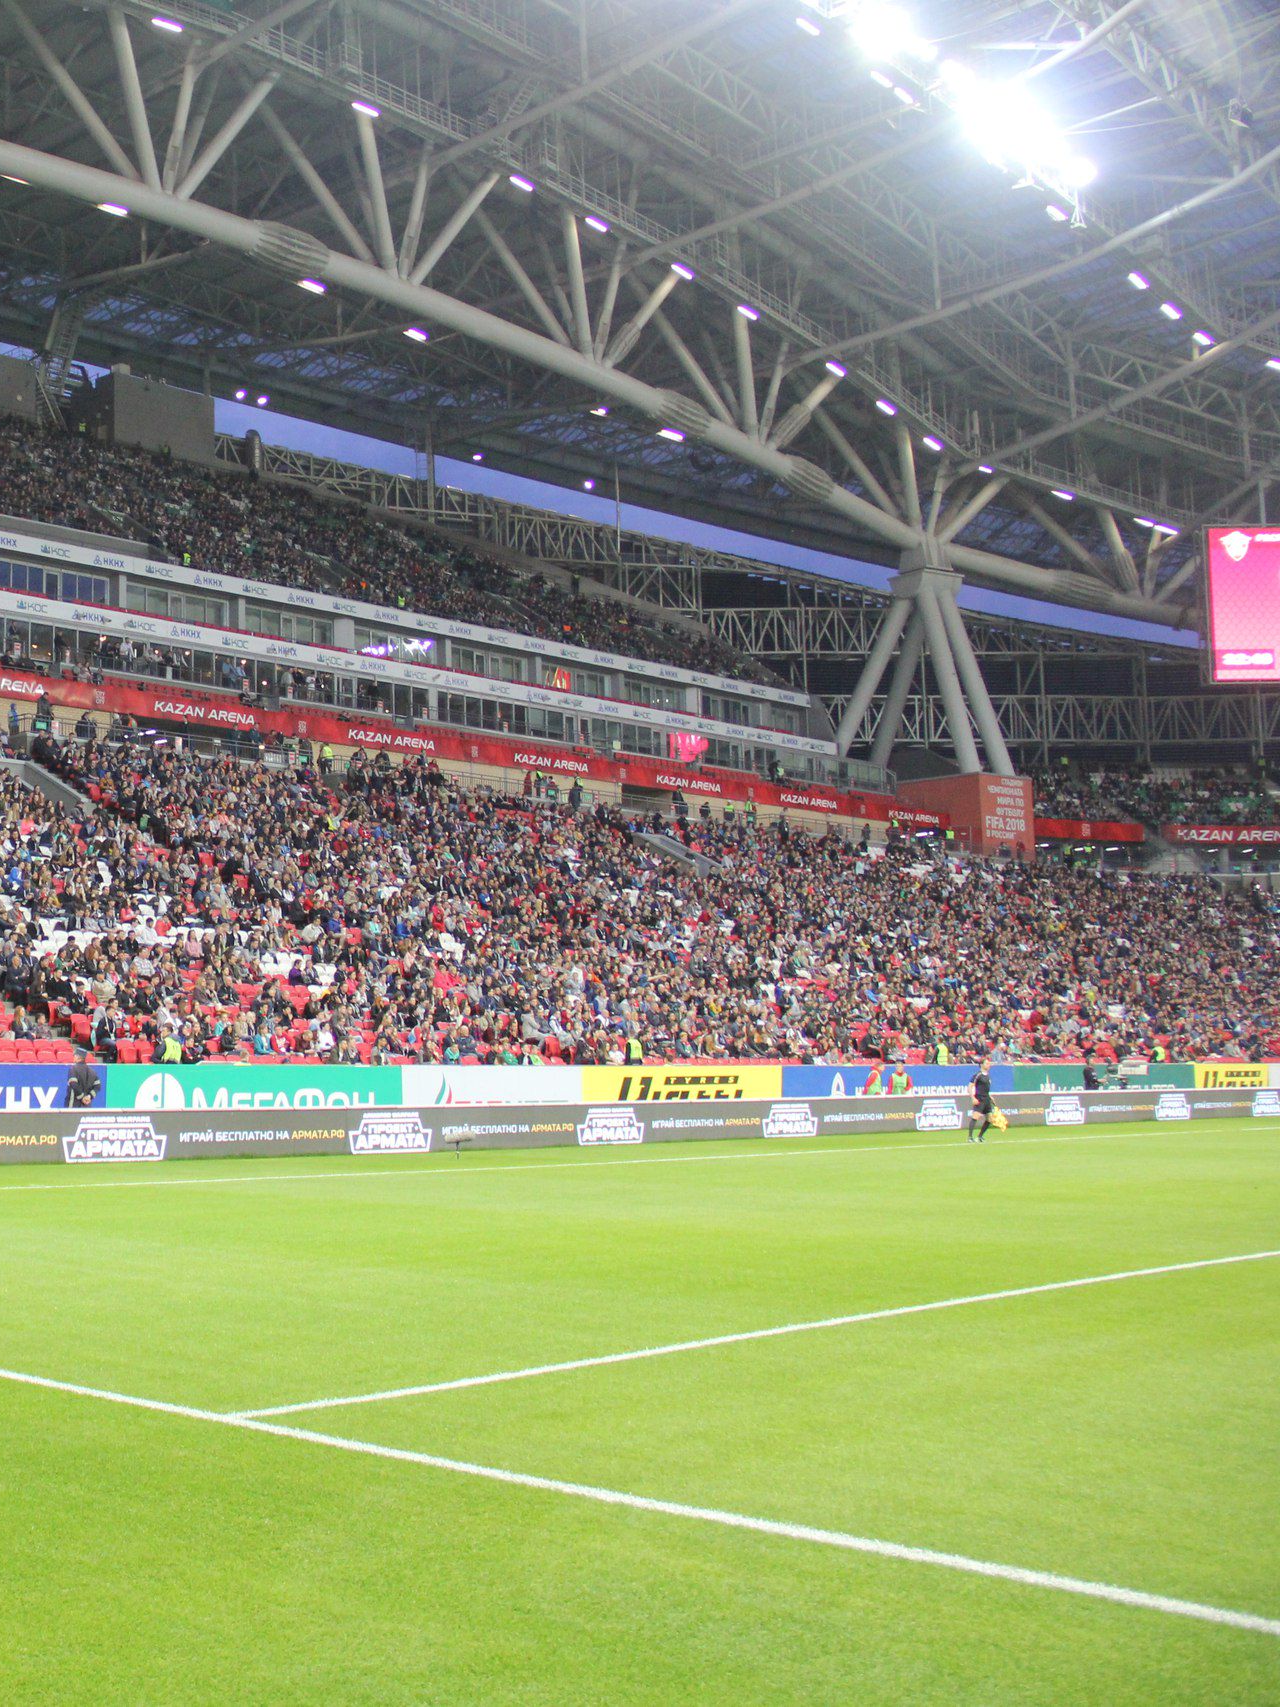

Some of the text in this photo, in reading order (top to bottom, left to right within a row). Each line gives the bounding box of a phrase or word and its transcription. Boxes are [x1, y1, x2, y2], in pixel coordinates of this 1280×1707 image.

[103, 557, 125, 569] НКНХ
[203, 576, 223, 588] НКНХ
[295, 594, 314, 606] НКНХ
[180, 628, 201, 639] НКНХ
[154, 701, 256, 726] KAZAN ARENA
[348, 728, 435, 751] KAZAN ARENA
[514, 753, 588, 773] KAZAN ARENA
[656, 774, 721, 793] KAZAN ARENA
[781, 793, 837, 809] KAZAN ARENA
[888, 810, 939, 824] KAZAN ARENA
[986, 816, 1025, 831] FIFA 2018
[1177, 829, 1233, 841] KAZAN
[670, 1076, 736, 1084] TYRES
[86, 1129, 144, 1140] ПРОЕКТ
[180, 1129, 345, 1142] ИГРАЙ БЕСПЛАТНО НА АРМАТА.РФ
[369, 1124, 414, 1134] ПРОЕКТ
[470, 1125, 517, 1135] БЕСПЛАТНО
[519, 1124, 530, 1133] НА
[582, 1127, 640, 1142] АРМАТА
[71, 1141, 159, 1157] АРМАТА
[356, 1134, 426, 1149] АРМАТА
